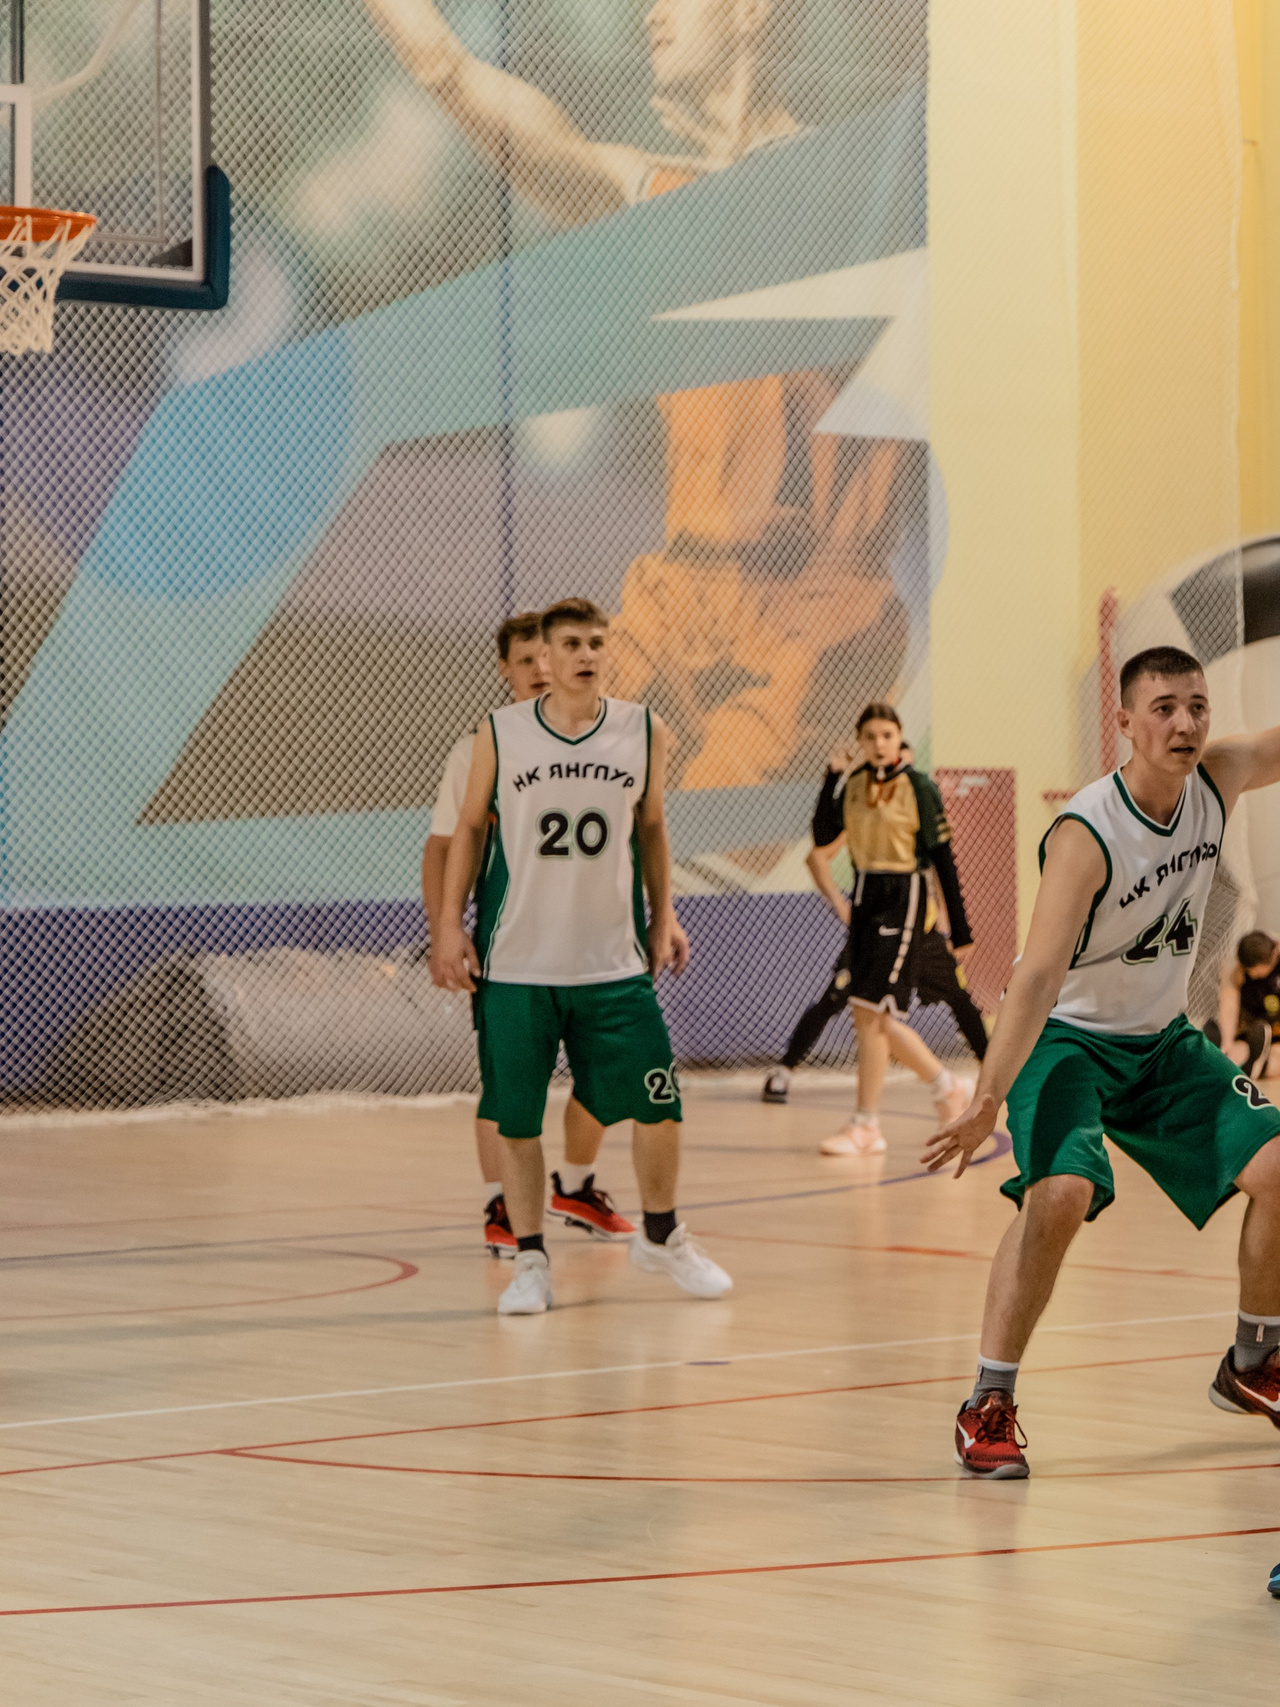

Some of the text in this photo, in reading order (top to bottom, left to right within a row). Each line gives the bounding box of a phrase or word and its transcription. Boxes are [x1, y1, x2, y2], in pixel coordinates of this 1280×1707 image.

[512, 762, 635, 793] НК ЯНГПУР
[537, 809, 610, 858] 20
[1123, 898, 1197, 964] 24
[644, 1062, 680, 1104] 2
